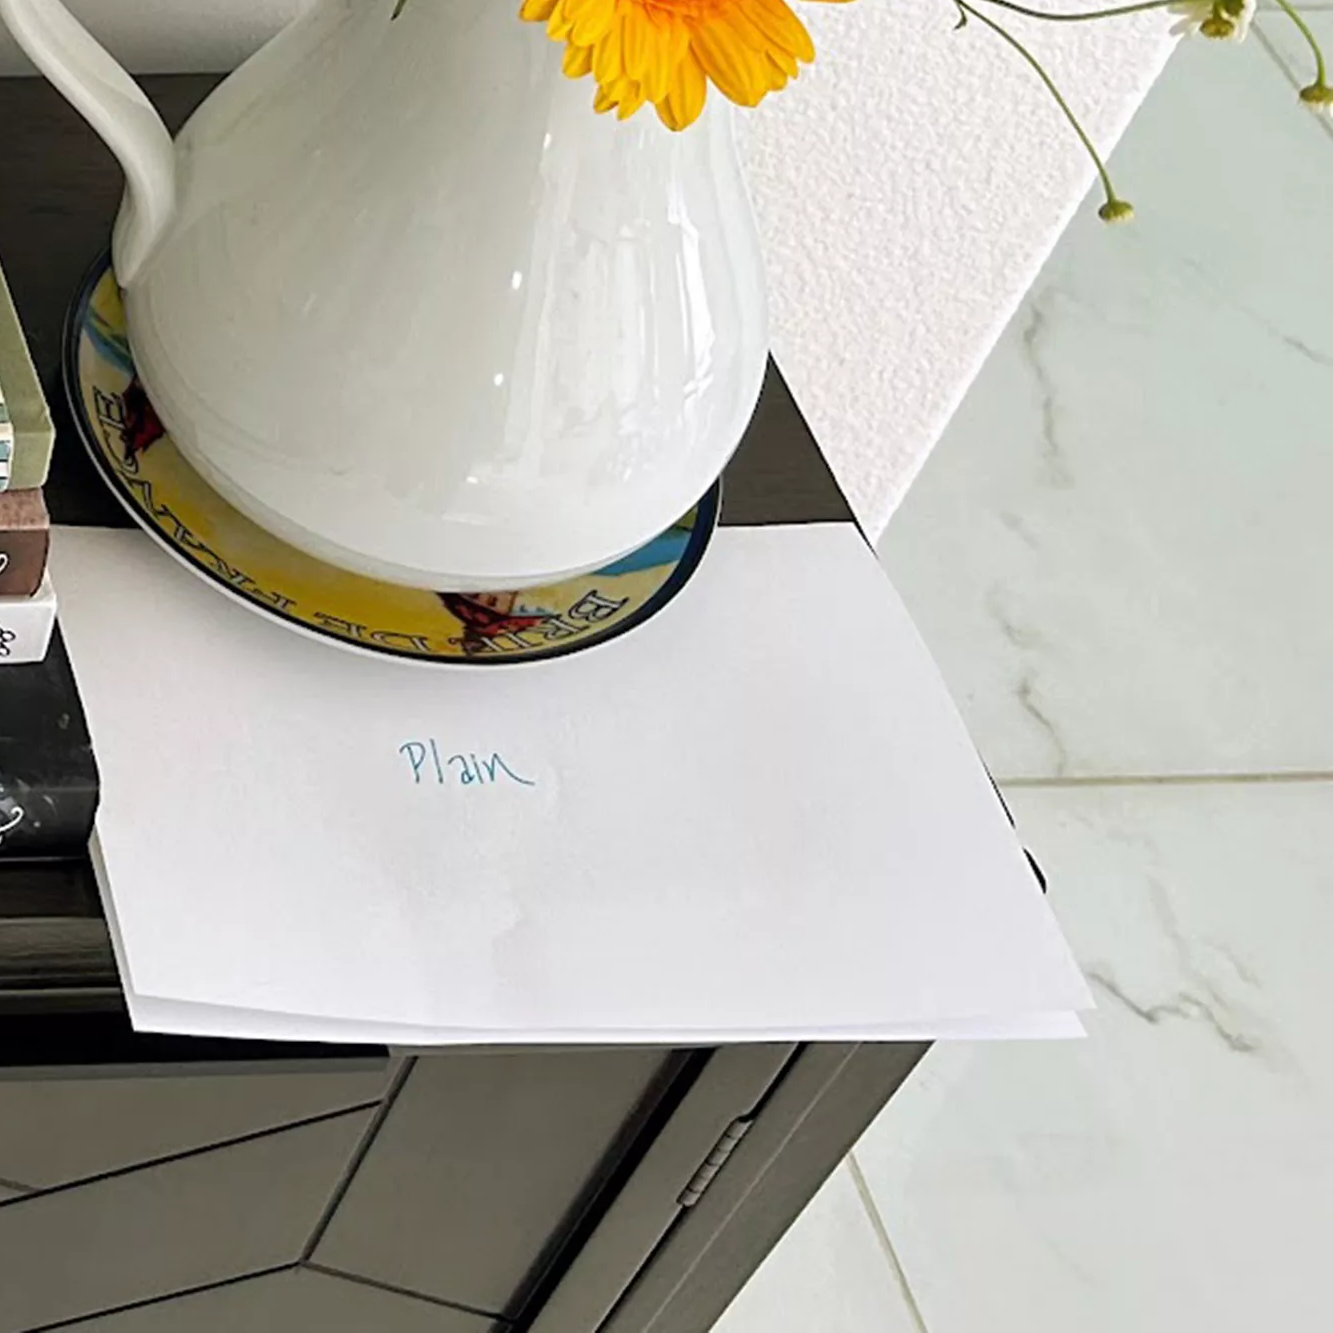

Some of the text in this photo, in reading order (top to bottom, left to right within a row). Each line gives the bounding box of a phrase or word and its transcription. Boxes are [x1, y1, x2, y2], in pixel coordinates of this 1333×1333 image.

[93, 385, 296, 611] FRANCE
[312, 609, 430, 653] DE
[398, 737, 536, 786] Plain
